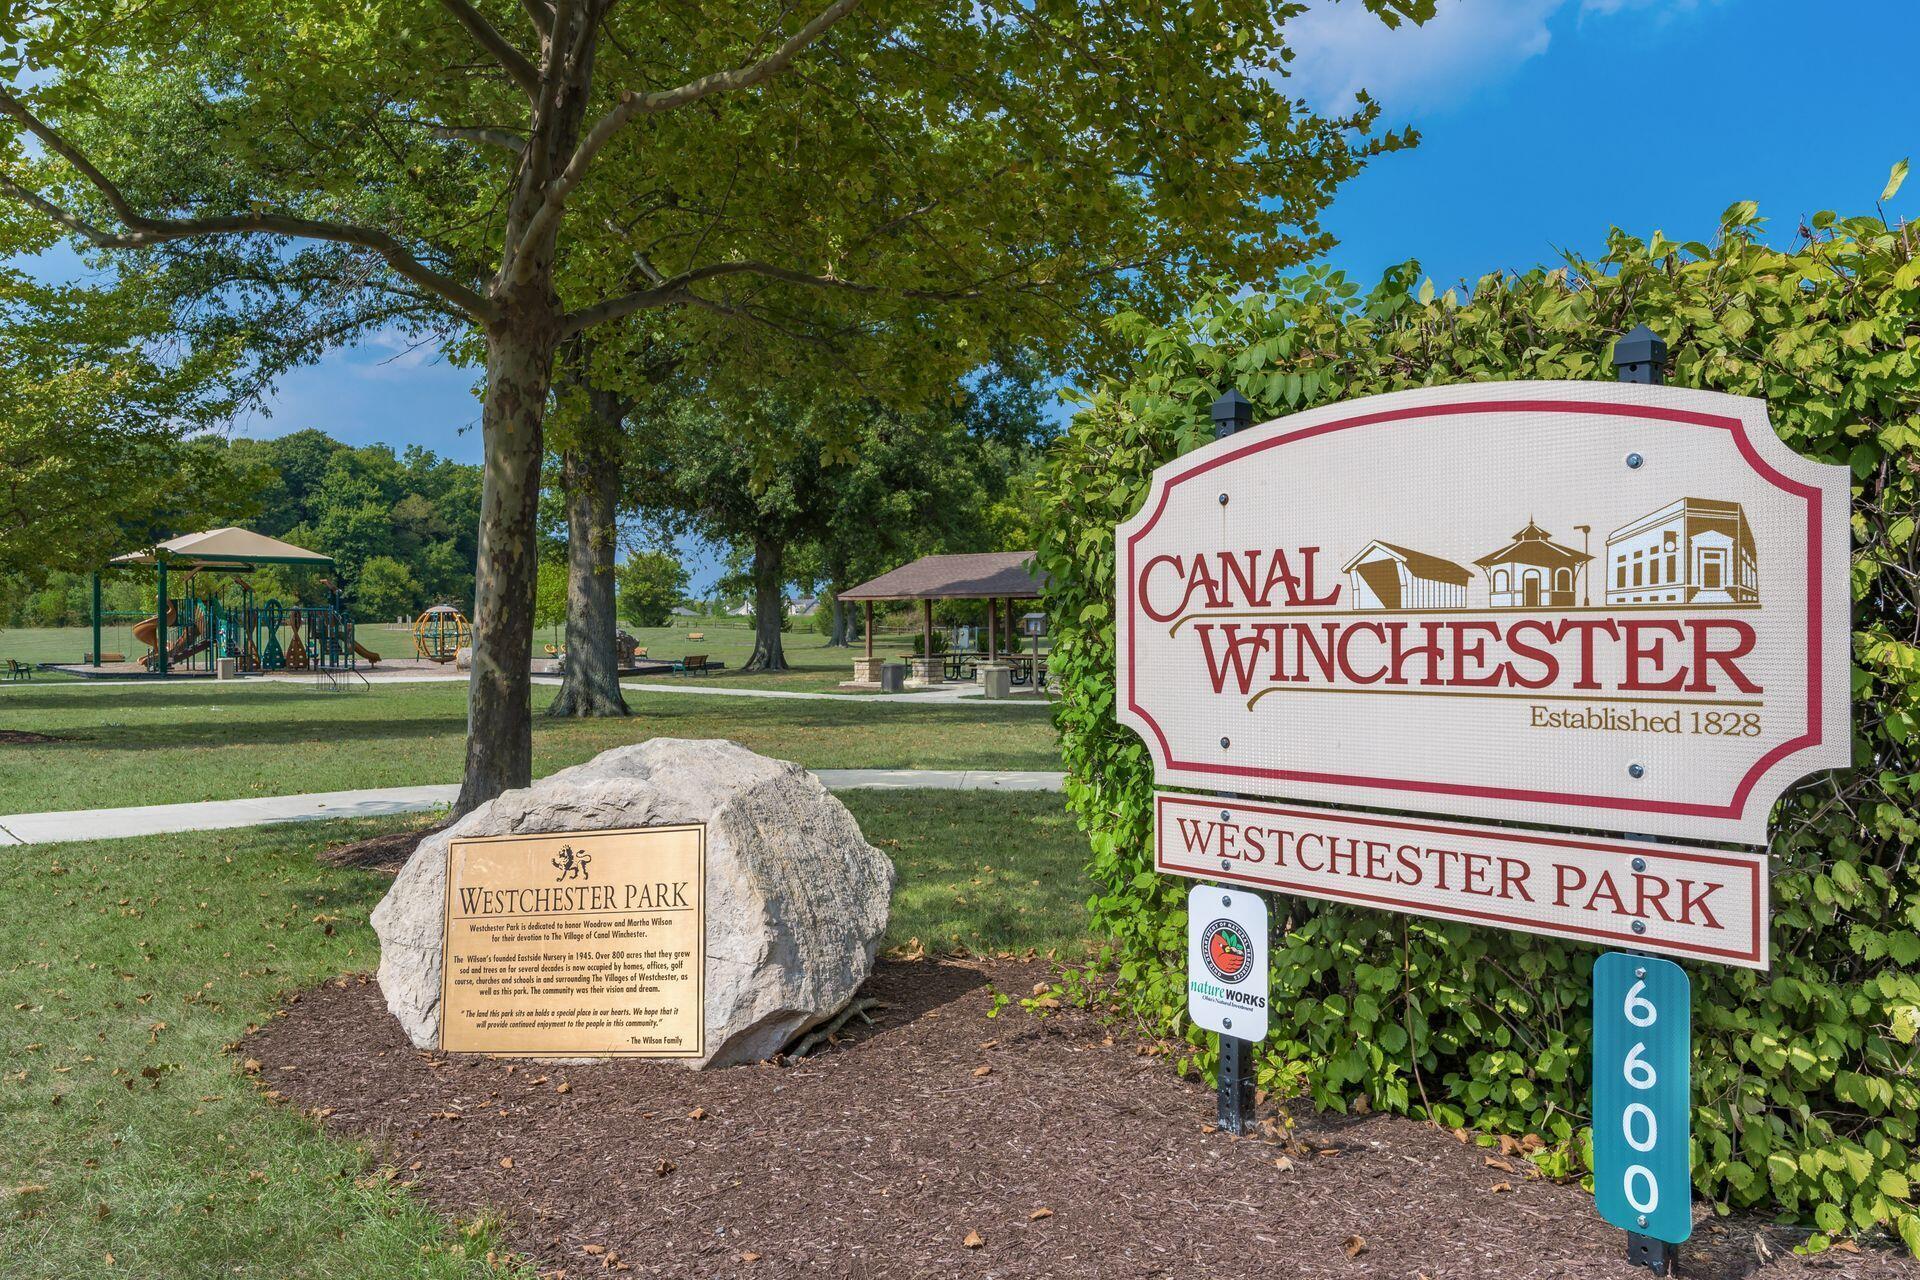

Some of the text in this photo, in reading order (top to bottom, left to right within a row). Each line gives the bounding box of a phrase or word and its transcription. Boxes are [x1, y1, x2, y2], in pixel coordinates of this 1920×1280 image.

[1138, 546, 1342, 623] CANAL
[1193, 617, 1764, 695] WINCHESTER
[1530, 705, 1762, 737] Established 1828
[1177, 817, 1725, 929] WESTCHESTER PARK
[460, 882, 689, 914] WESTCHESTER PARK
[528, 922, 555, 930] dedicated
[565, 920, 581, 929] honor
[564, 931, 584, 942] Village
[586, 931, 593, 939] of
[594, 930, 610, 938] Canal
[612, 930, 647, 938] Winchester.
[494, 954, 516, 962] founded
[518, 953, 540, 961] Eastside
[543, 952, 566, 962] Nursery
[568, 952, 573, 960] in
[576, 952, 593, 960] 1945.
[596, 951, 610, 959] Over
[612, 950, 624, 959] 800
[644, 950, 656, 958] that
[659, 949, 672, 959] they
[460, 966, 469, 974] sod
[587, 962, 612, 972] occupied
[614, 962, 621, 972] by
[623, 961, 644, 970] homes,
[647, 960, 668, 970] offices,
[671, 960, 683, 971] golf
[556, 974, 590, 984] surrounding
[605, 973, 628, 983] Villages
[639, 973, 678, 982] Westchester,
[514, 987, 528, 996] park.
[543, 986, 574, 995] community
[639, 984, 660, 992] dream.
[501, 1009, 513, 1018] park
[535, 1008, 549, 1016] holds
[557, 1007, 575, 1018] special
[577, 1008, 591, 1018] place
[593, 1007, 598, 1016] in
[644, 1007, 658, 1016] hope
[660, 1006, 672, 1015] that
[487, 1020, 508, 1029] provide
[510, 1019, 535, 1028] continued
[537, 1020, 565, 1029] enjoyment
[586, 1019, 605, 1029] people
[664, 1036, 682, 1046] Family
[1622, 979, 1659, 1214] 6600
